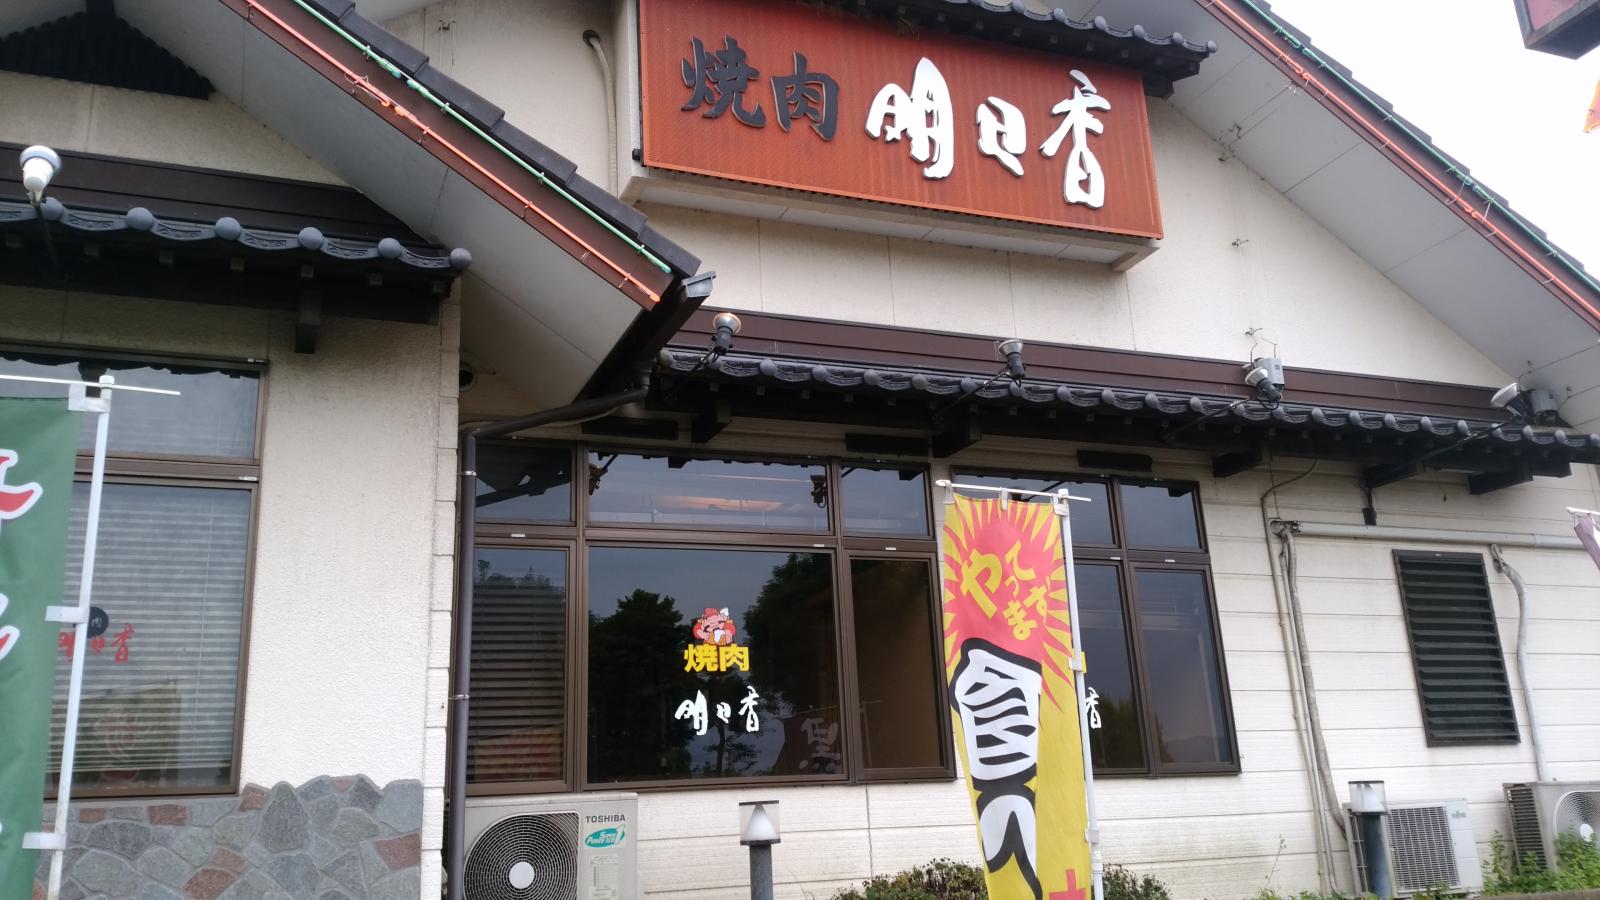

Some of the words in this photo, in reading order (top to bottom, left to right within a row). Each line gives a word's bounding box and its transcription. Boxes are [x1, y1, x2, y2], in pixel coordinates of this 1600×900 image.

[681, 35, 839, 141] 焼肉
[865, 57, 1112, 209] 明日香
[683, 643, 750, 673] 焼肉
[674, 685, 760, 736] 明日香
[585, 814, 626, 824] TOSHIBA
